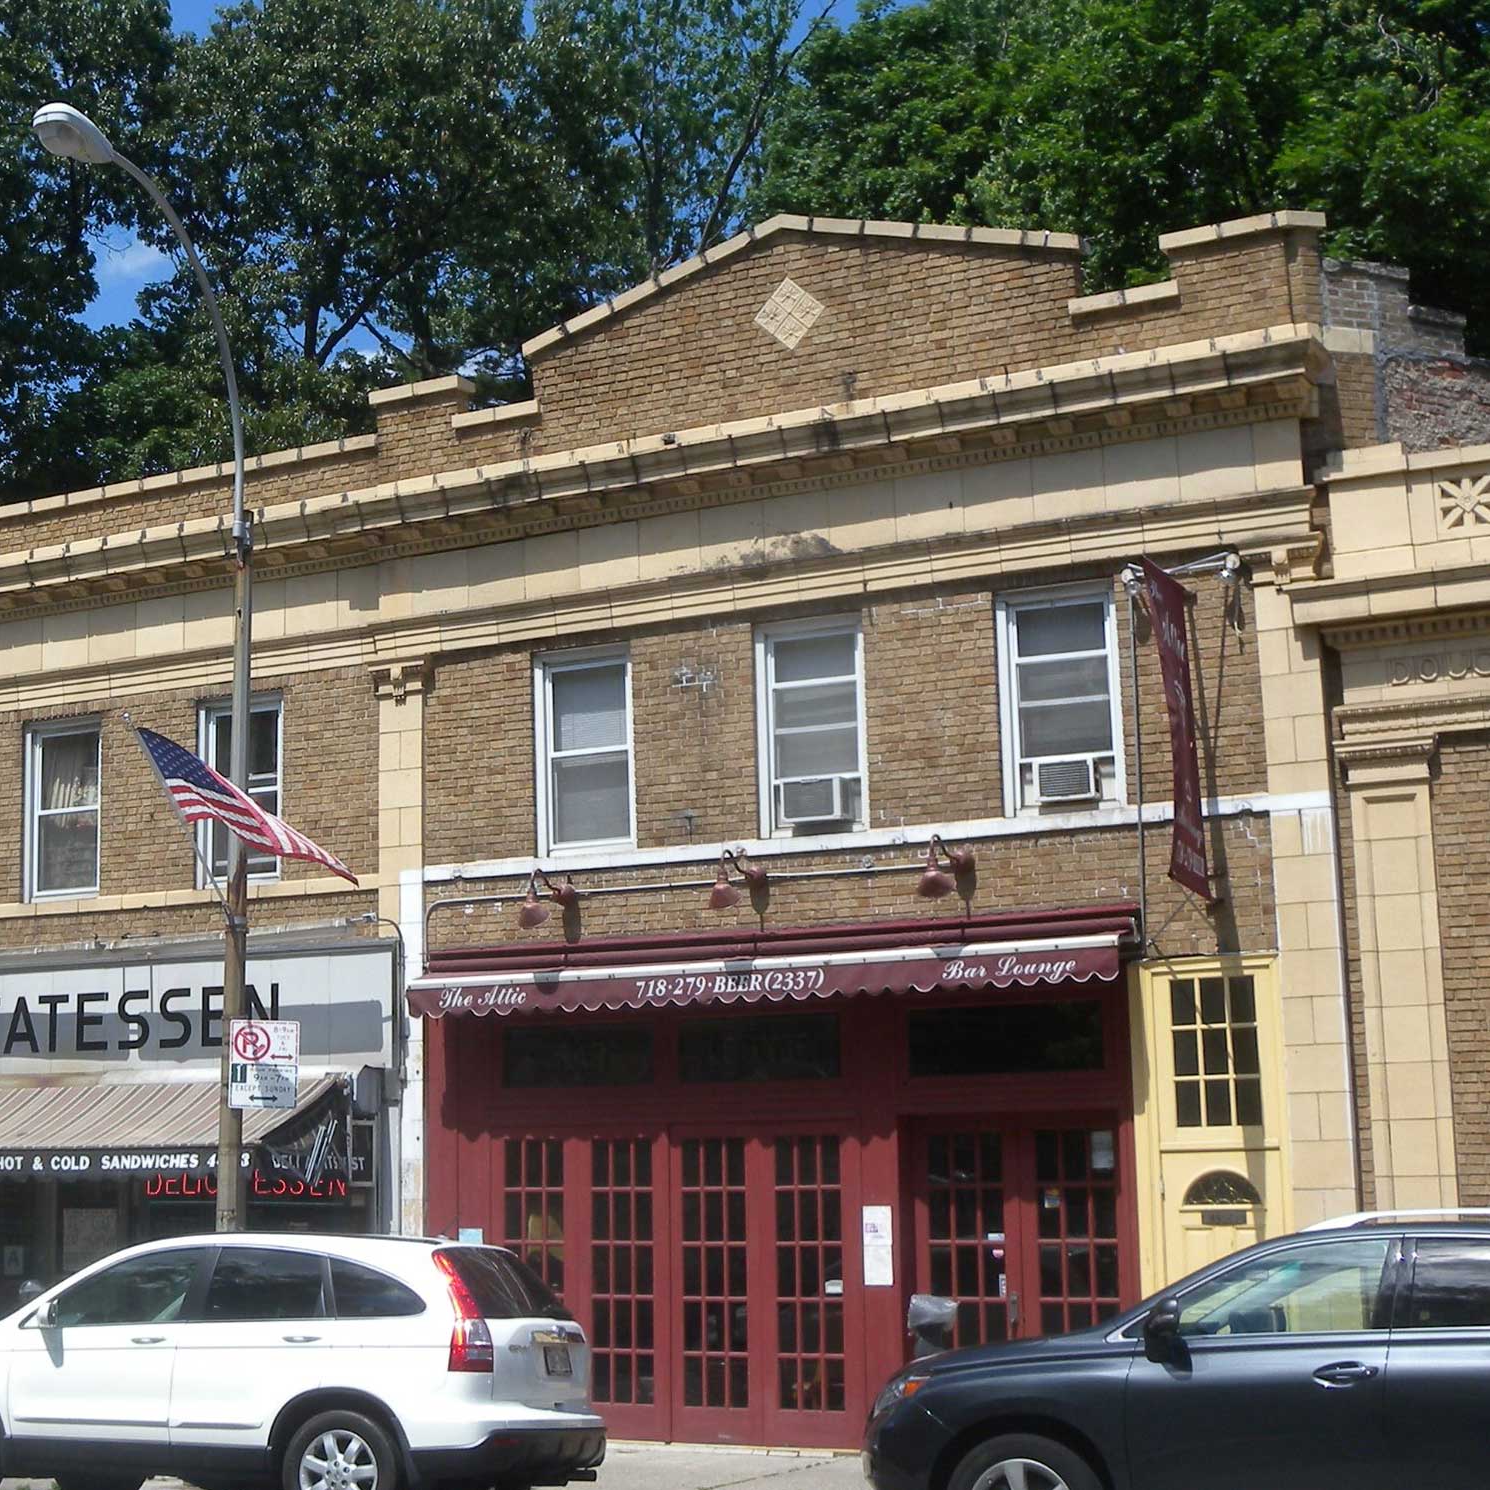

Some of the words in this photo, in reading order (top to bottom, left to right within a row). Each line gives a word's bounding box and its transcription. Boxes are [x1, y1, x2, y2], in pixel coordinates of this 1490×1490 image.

[438, 986, 473, 1009] The
[477, 985, 527, 1006] Attic
[941, 960, 987, 980] Bar
[995, 956, 1077, 981] Lounge
[235, 1084, 261, 1092] EXCEPT
[265, 1085, 290, 1093] SUNDAY
[32, 1156, 43, 1171] &
[51, 1155, 90, 1171] COLD
[101, 1153, 199, 1171] SANDWICHES
